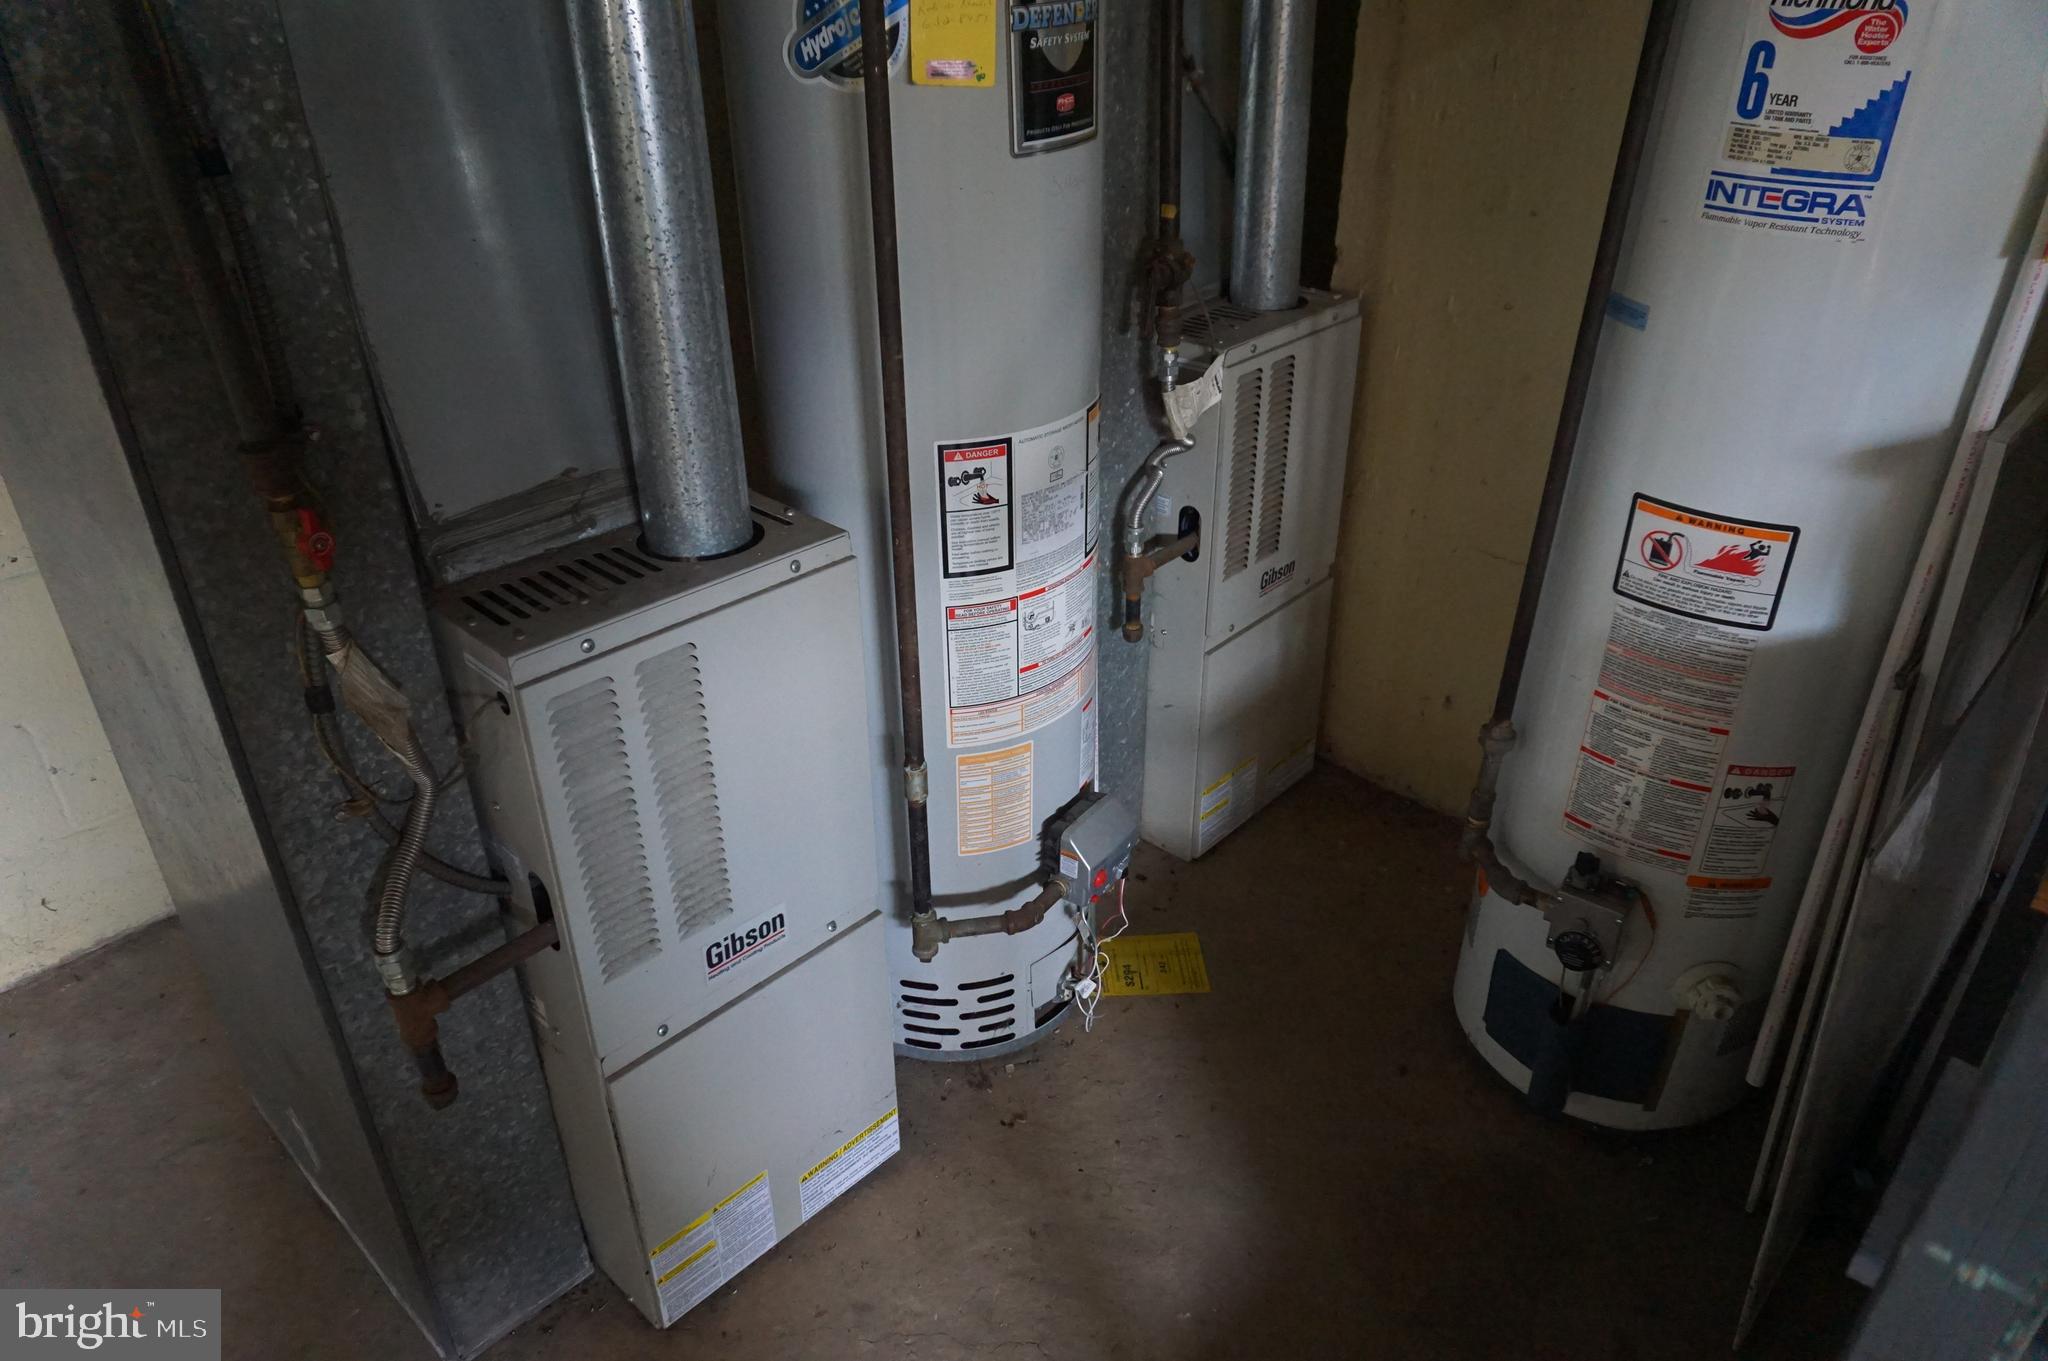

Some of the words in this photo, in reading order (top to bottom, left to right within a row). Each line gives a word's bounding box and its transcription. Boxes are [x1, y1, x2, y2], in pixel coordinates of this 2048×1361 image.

[1871, 17, 1887, 26] The
[1029, 34, 1063, 49] SAFETY
[1064, 30, 1091, 44] SYSTEM
[1736, 40, 1776, 120] 6
[1769, 93, 1799, 107] YEAR
[1705, 178, 1866, 217] INTEGRA
[1700, 211, 1742, 225] Flammable
[1743, 218, 1768, 230] Vapor
[1768, 222, 1809, 233] Resistant
[1809, 226, 1862, 239] Technology
[1820, 217, 1865, 227] SYSTEM
[965, 449, 999, 459] DANGER
[1688, 518, 1745, 535] WARNING
[1260, 560, 1295, 590] Gibson
[1744, 767, 1792, 777] DANGER
[706, 913, 785, 969] Gibson
[742, 947, 763, 960] Cooling
[807, 1151, 839, 1178] WARNING
[843, 1107, 897, 1153] ADVERTISSEMENT
